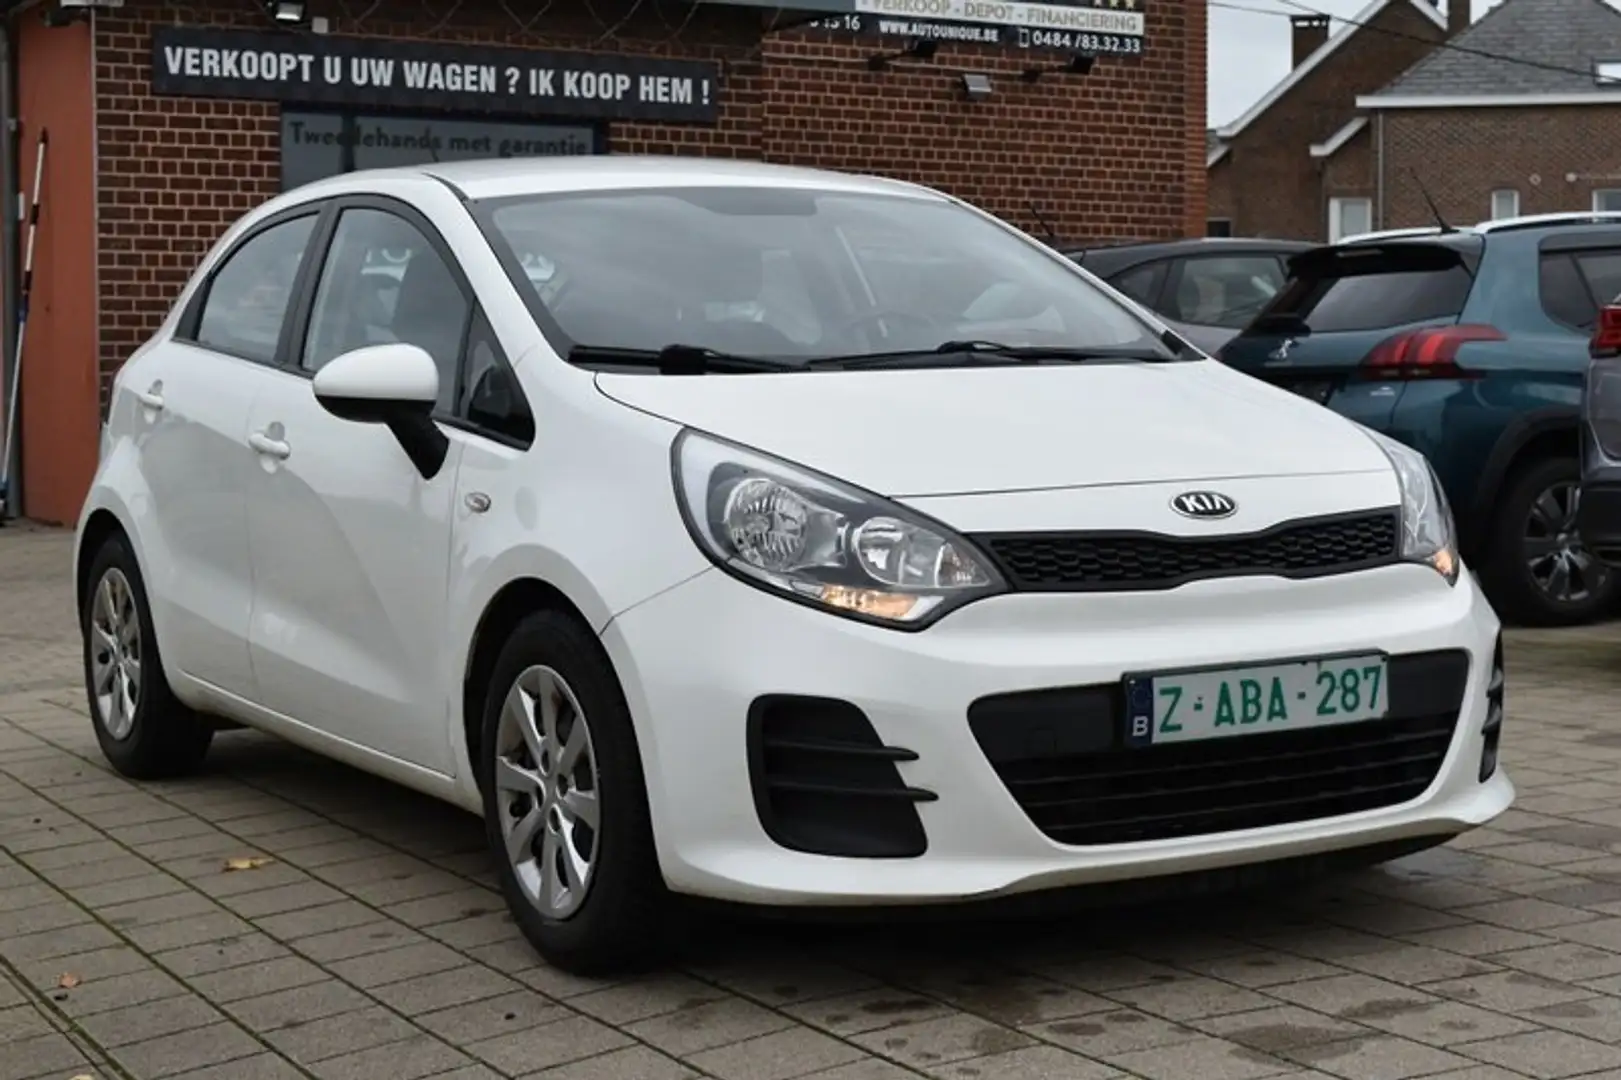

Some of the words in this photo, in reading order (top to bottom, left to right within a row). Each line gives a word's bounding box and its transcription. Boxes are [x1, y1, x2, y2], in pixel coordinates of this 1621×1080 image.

[964, 2, 1014, 20] DEPOT
[1027, 8, 1137, 31] FINANCIERING
[1032, 30, 1071, 48] 0484
[164, 45, 315, 82] VERKOOPT
[323, 56, 342, 84] U
[351, 57, 395, 87] UW
[403, 60, 496, 93] WAGEN
[529, 69, 555, 97] IK
[563, 71, 631, 100] KOOP
[638, 76, 692, 104] HEM
[449, 135, 492, 152] met
[498, 133, 587, 157] garantie
[1180, 493, 1232, 512] KIA
[1132, 715, 1149, 737] B
